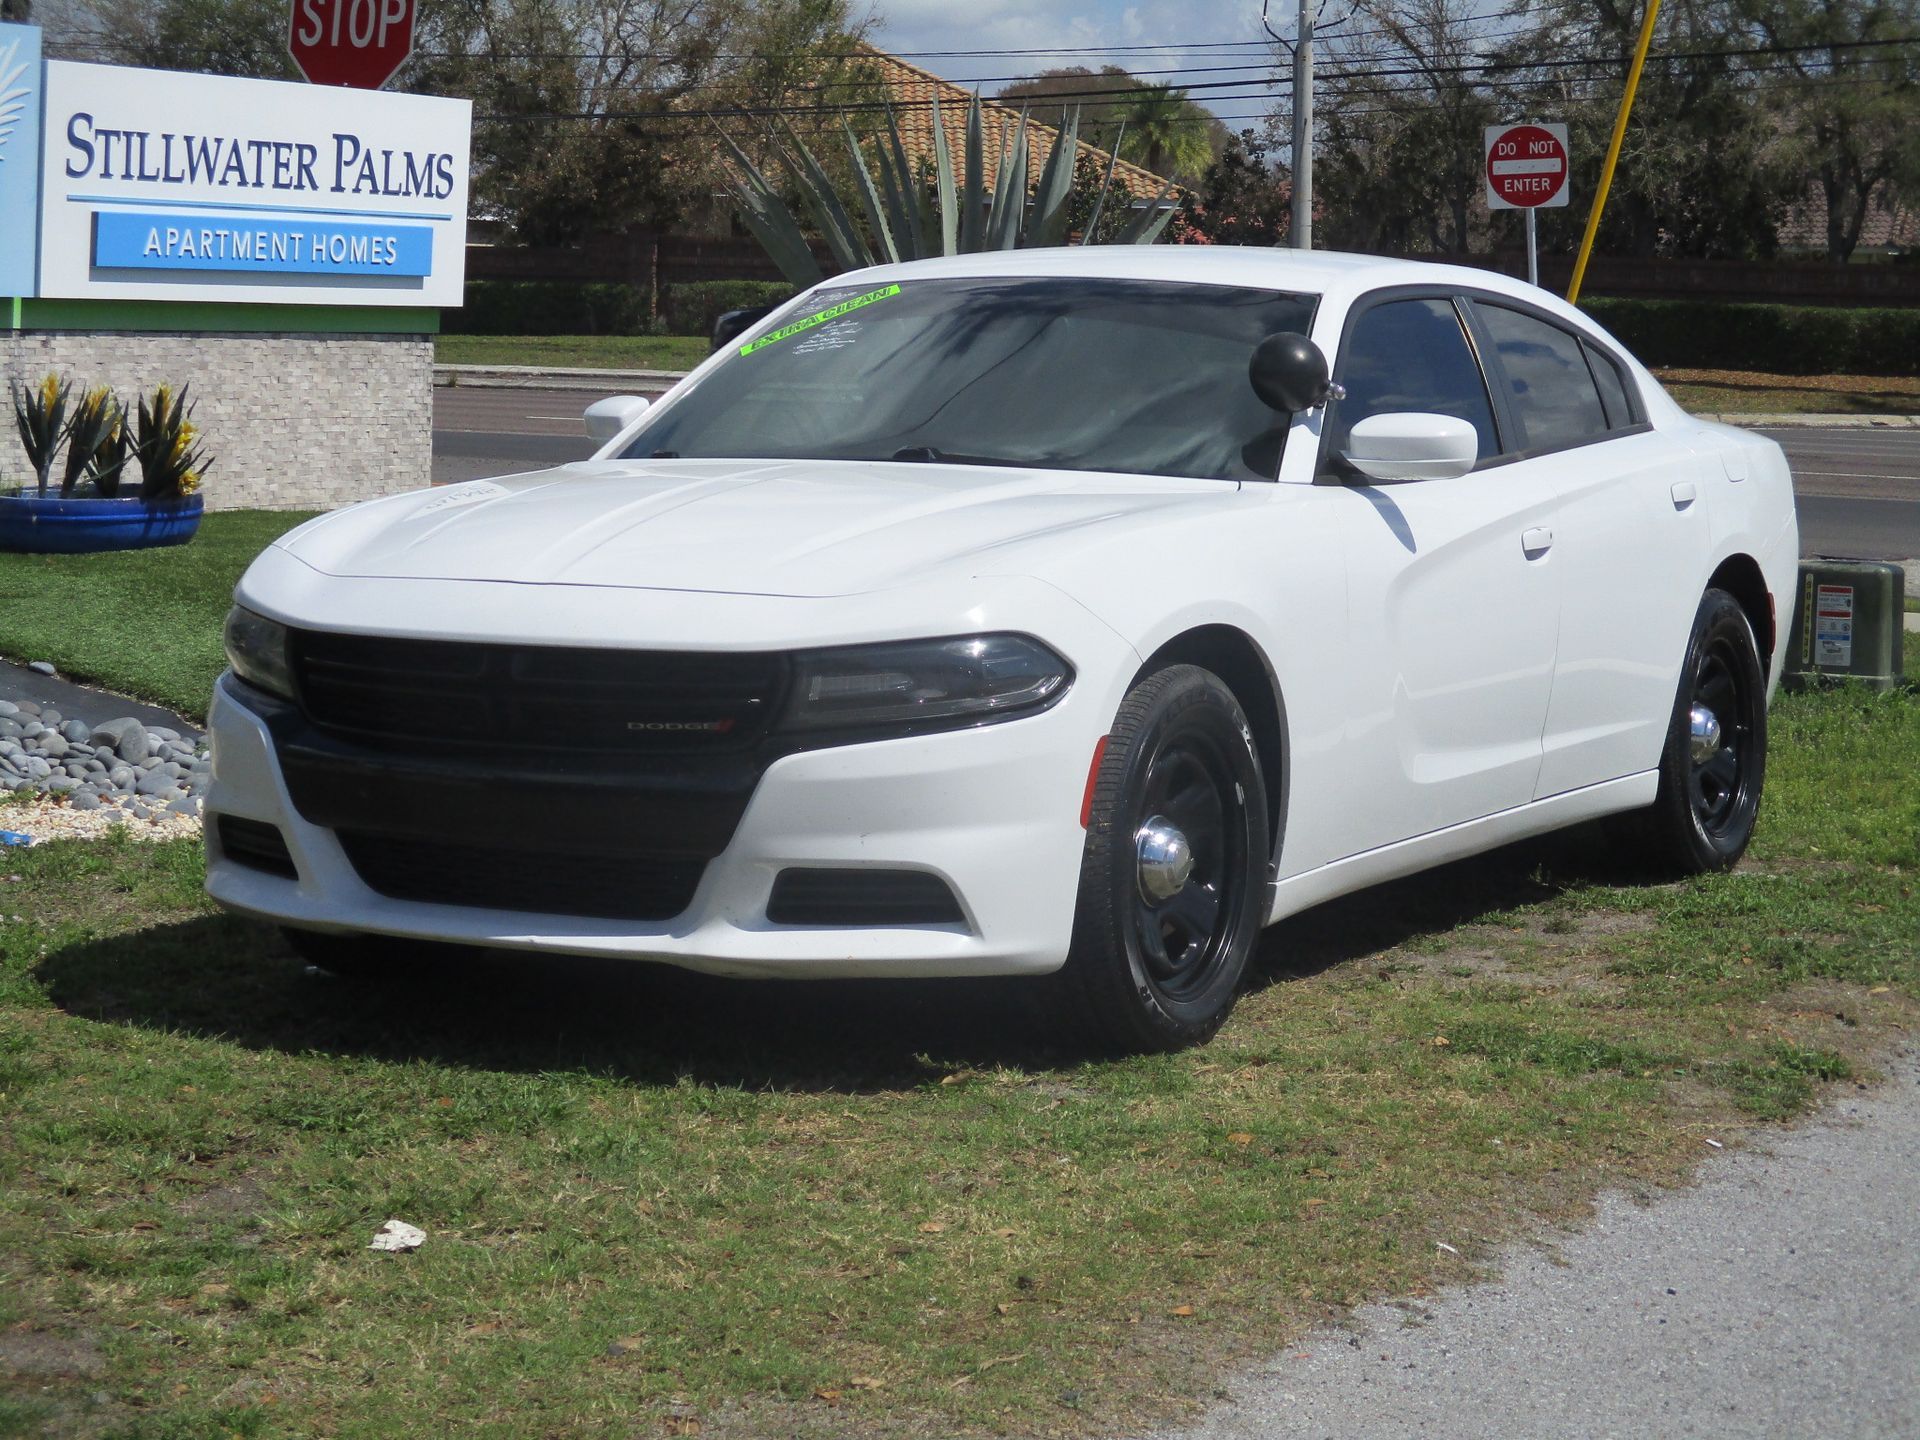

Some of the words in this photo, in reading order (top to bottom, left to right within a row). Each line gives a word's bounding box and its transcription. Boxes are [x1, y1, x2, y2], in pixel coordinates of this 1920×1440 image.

[298, 0, 407, 48] STOP
[66, 112, 319, 192] STILLWATER
[330, 133, 454, 199] PALMS
[1498, 143, 1517, 156] DO
[1529, 141, 1555, 154] NOT
[1504, 178, 1551, 192] ENTER
[144, 227, 304, 262] APARTMENT
[312, 233, 398, 265] HOMES
[751, 316, 821, 348] EXTRA
[627, 721, 721, 730] DODGE
